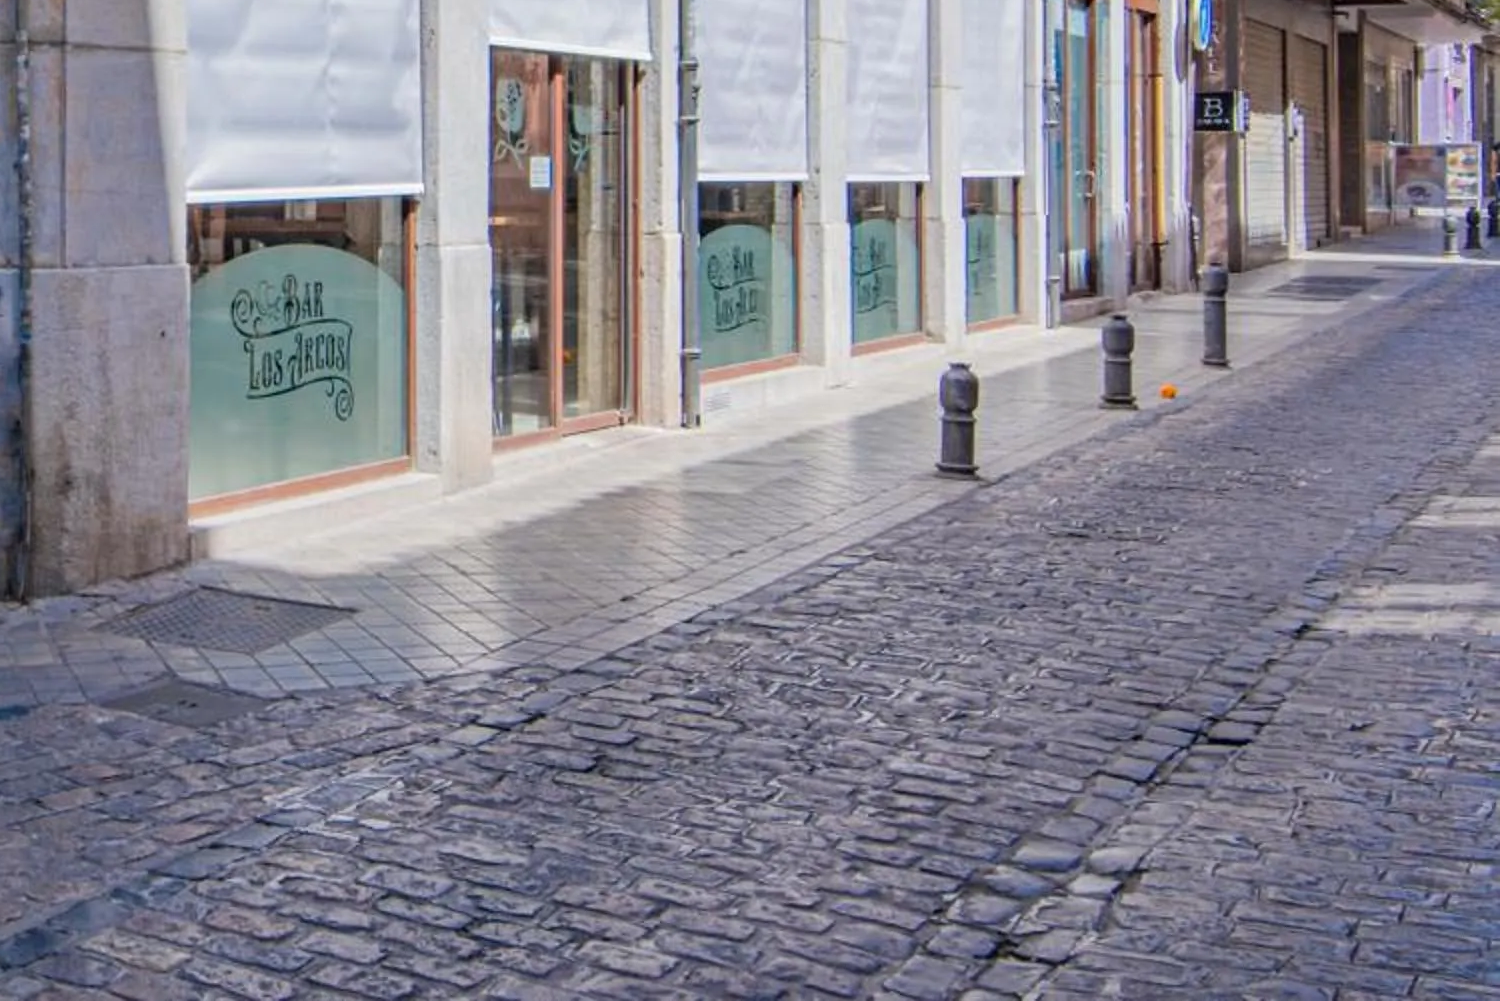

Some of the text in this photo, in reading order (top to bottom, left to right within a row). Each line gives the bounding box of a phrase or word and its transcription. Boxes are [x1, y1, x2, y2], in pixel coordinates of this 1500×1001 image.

[1203, 98, 1223, 118] B
[282, 274, 324, 326] BAR
[244, 332, 346, 390] LOS ARCOS
